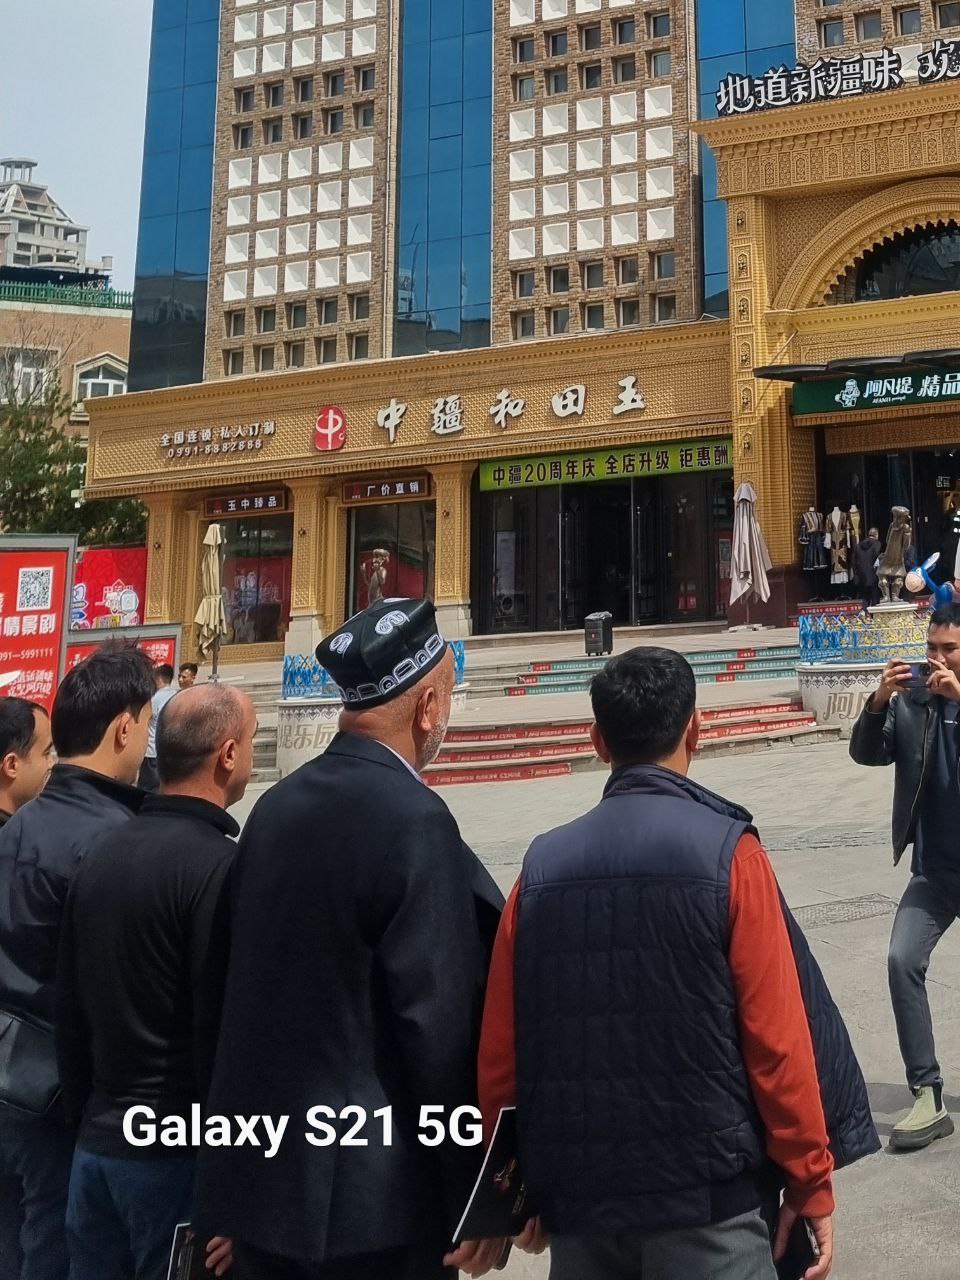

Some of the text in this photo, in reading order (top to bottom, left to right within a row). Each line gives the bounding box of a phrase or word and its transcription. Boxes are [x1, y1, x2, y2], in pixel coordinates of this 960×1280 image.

[716, 48, 901, 114] 地道新疆味
[863, 376, 914, 399] 阿凡提
[377, 375, 646, 443] 中疆和田玉
[167, 438, 263, 459] 0991-8882888
[492, 443, 733, 488] 中疆20周年庆 全店升级 钜惠酬
[366, 480, 419, 497] 厂价直销
[0, 613, 56, 637] 情景剧
